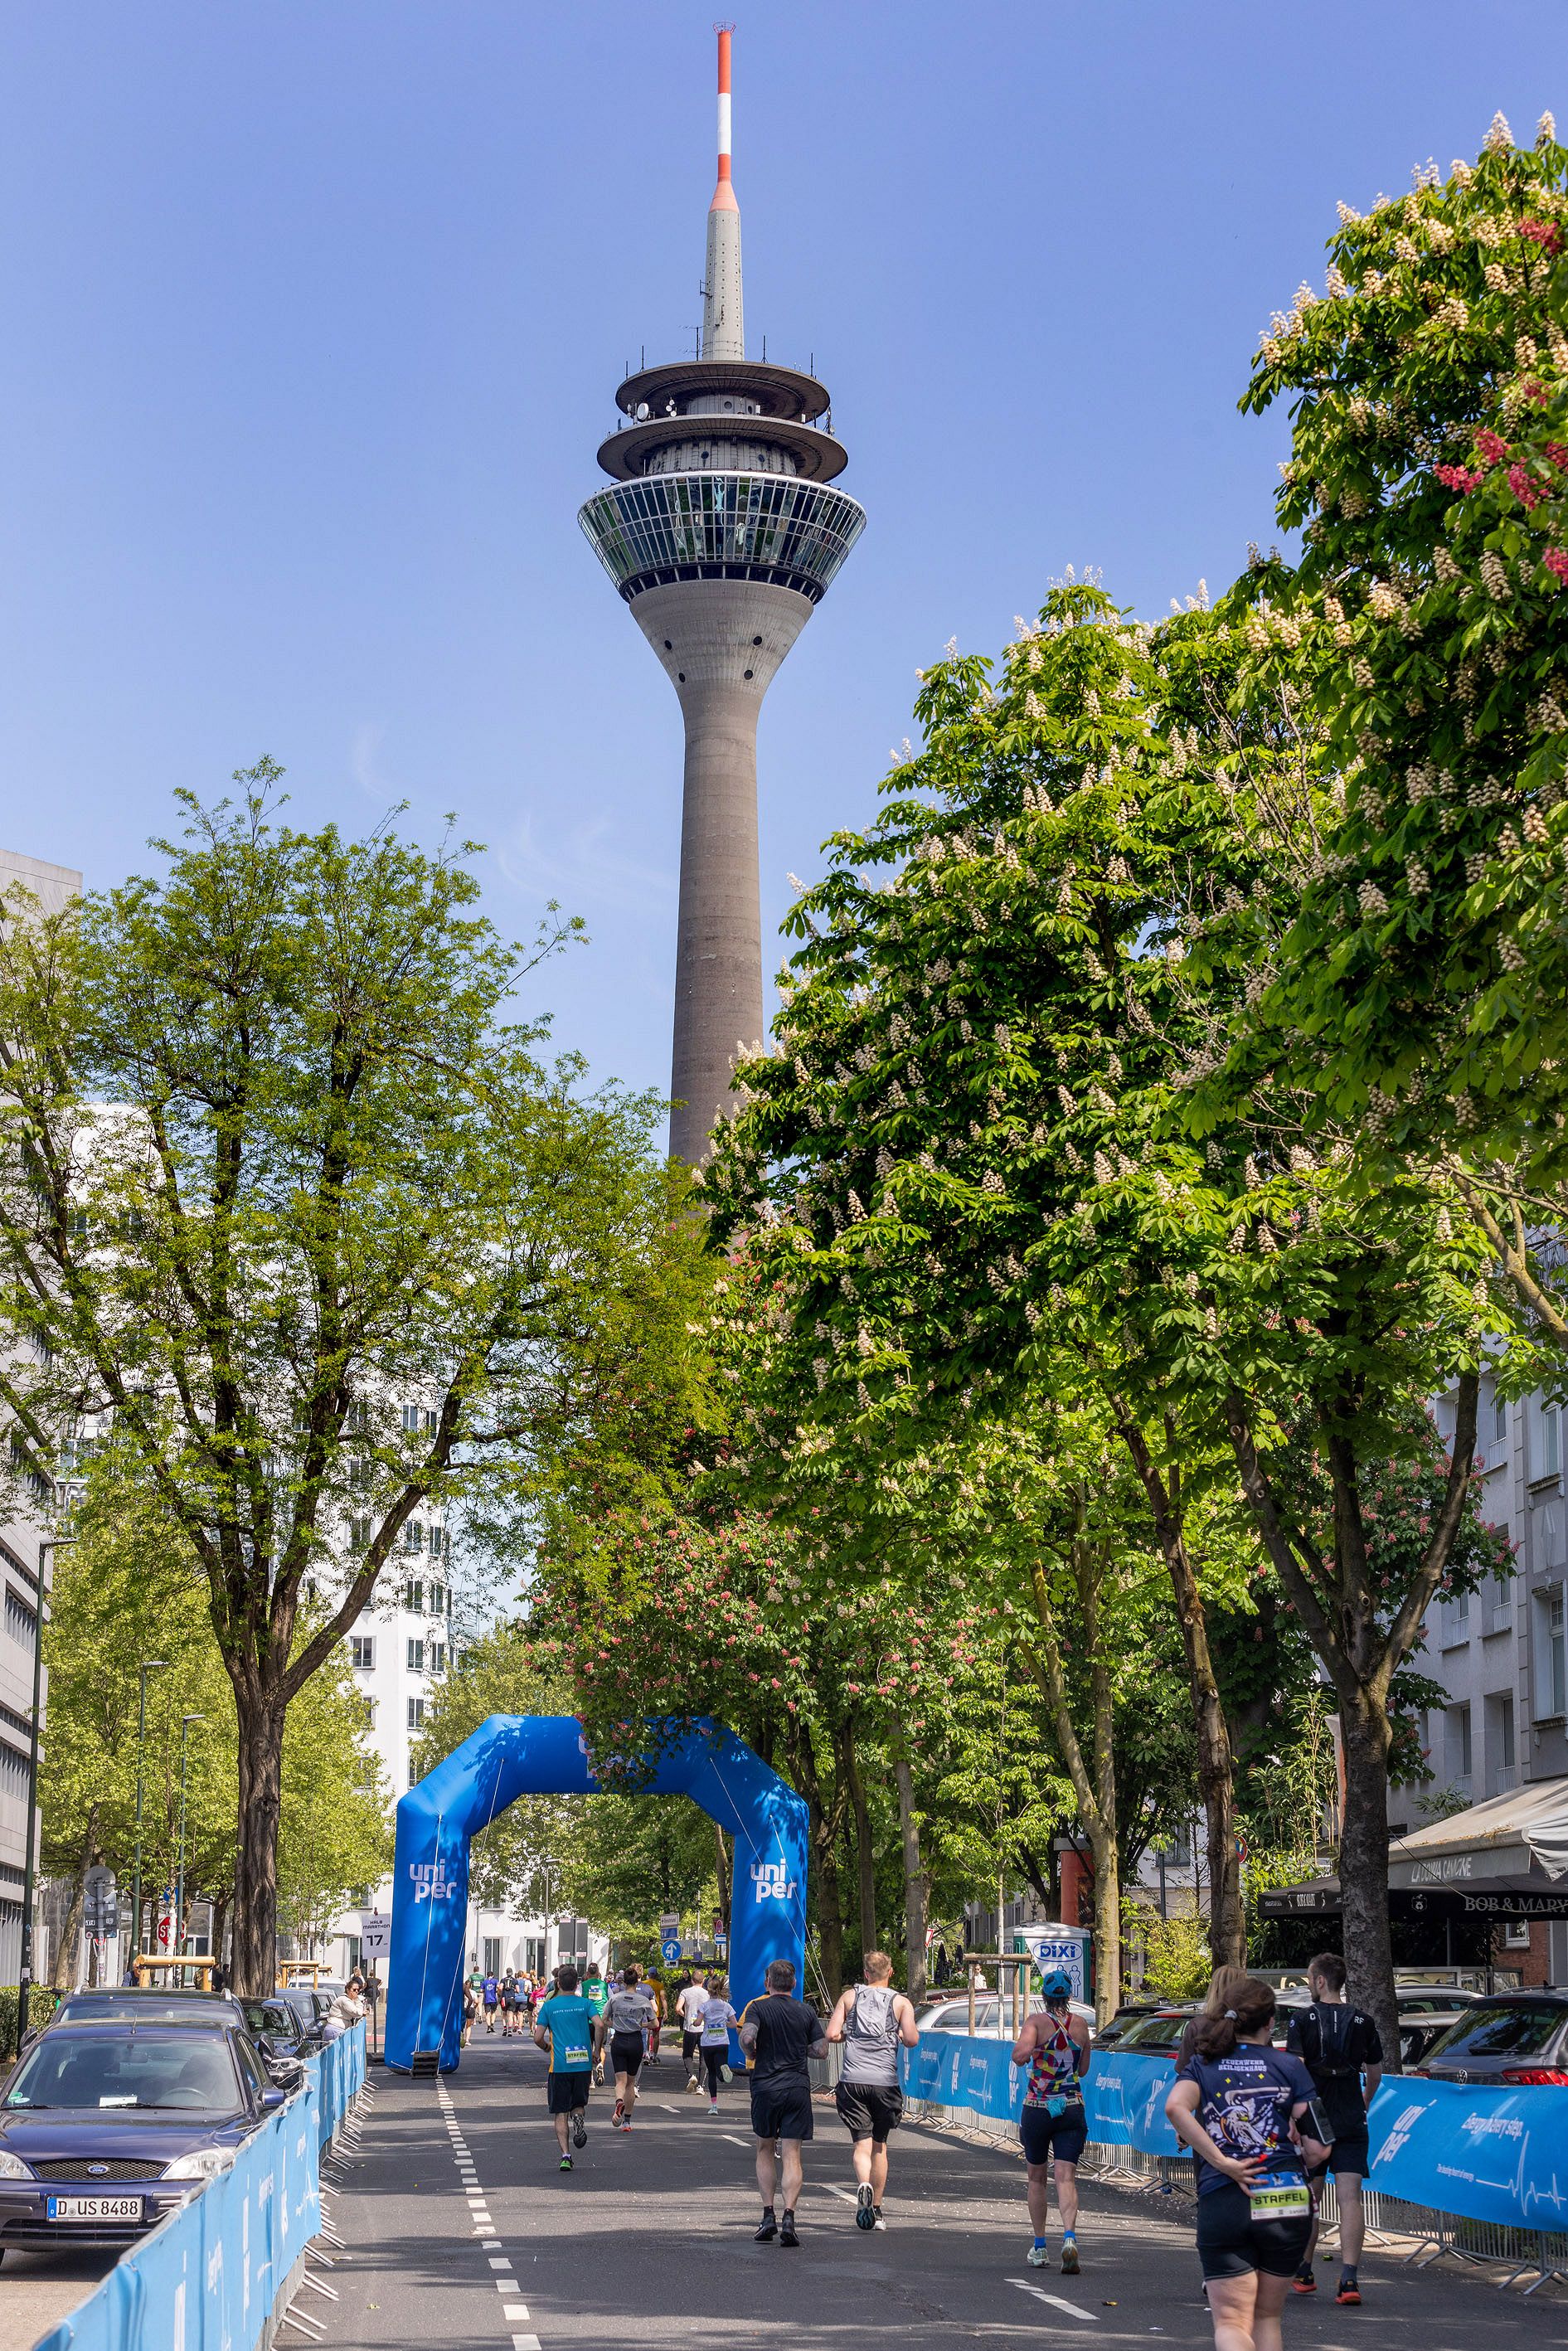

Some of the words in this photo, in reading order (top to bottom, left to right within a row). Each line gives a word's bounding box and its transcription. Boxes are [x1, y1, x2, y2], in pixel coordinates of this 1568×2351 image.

[410, 1858, 445, 1881] uni
[750, 1858, 786, 1881] uni
[415, 1881, 457, 1903] per
[756, 1881, 797, 1903] per
[1464, 1897, 1499, 1911] BOB
[1502, 1897, 1513, 1911] &
[1518, 1897, 1568, 1912] MARY
[366, 1934, 383, 1946] 17
[1218, 2064, 1268, 2072] HEILIGENHAUS
[1371, 2132, 1411, 2170] per
[1255, 2193, 1305, 2205] STAFFEL
[58, 2201, 67, 2215] D
[78, 2201, 97, 2215] US
[100, 2201, 138, 2216] 8488
